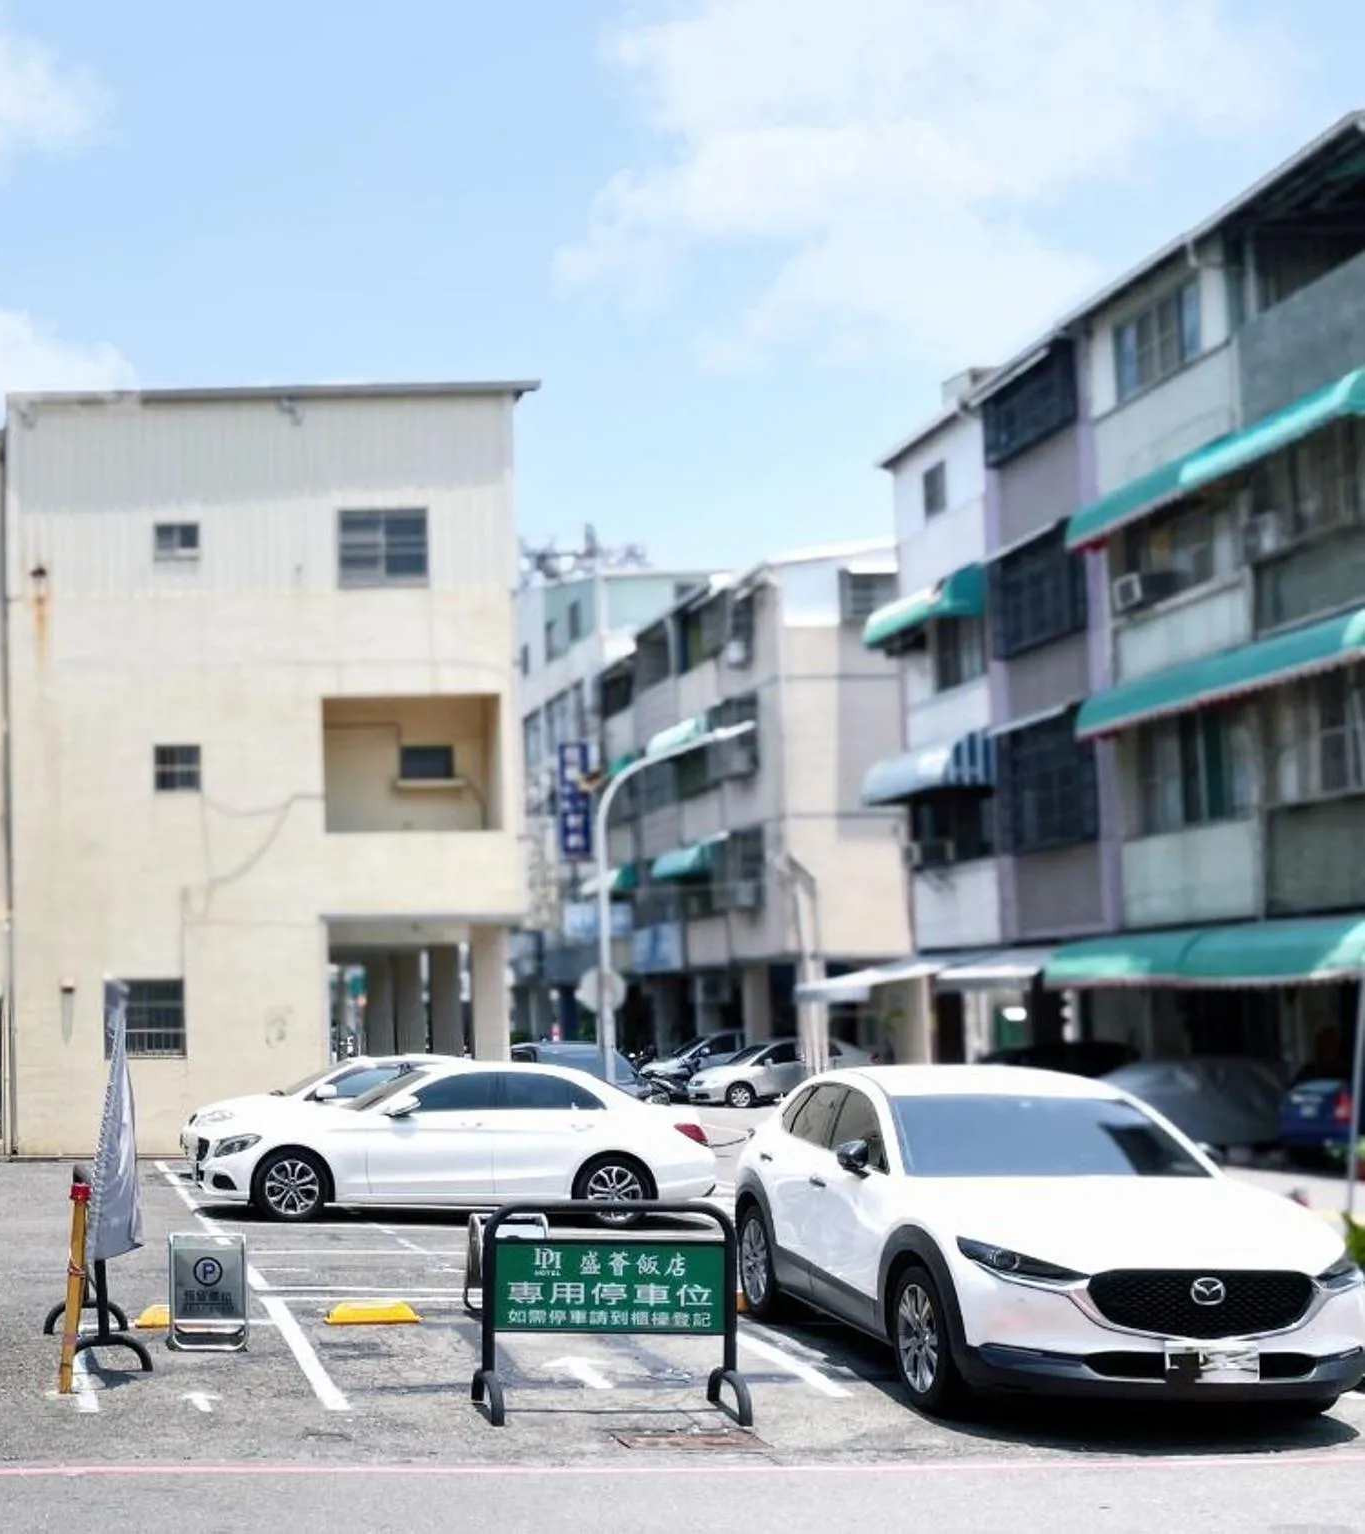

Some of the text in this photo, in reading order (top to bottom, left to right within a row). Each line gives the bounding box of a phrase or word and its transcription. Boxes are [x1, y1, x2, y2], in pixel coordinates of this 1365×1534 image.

[507, 1281, 713, 1307] 專用停車位
